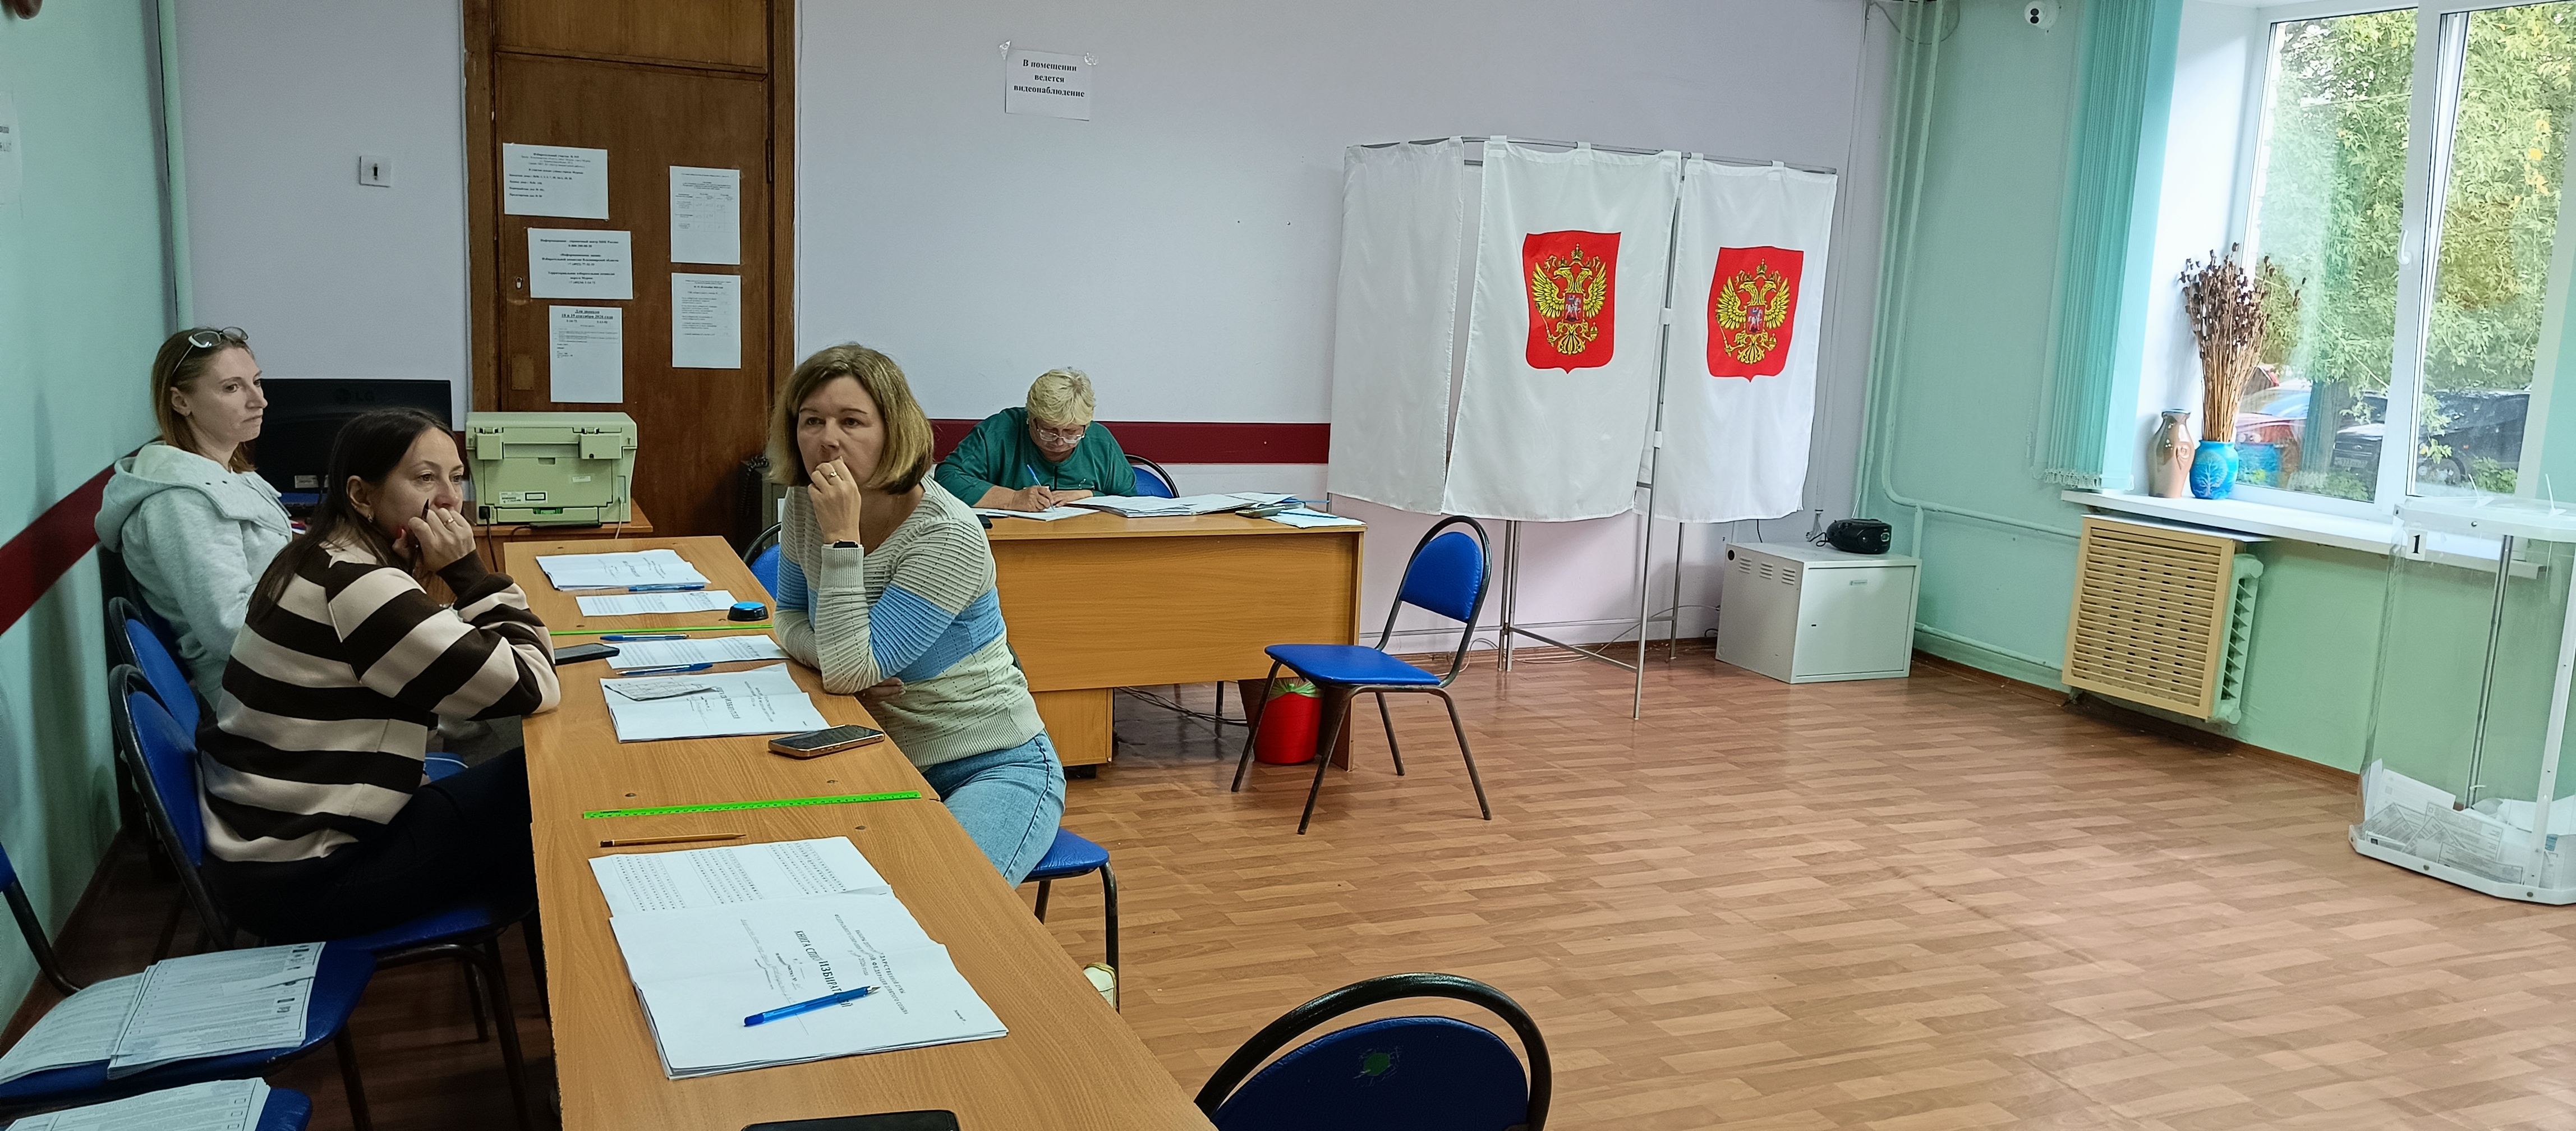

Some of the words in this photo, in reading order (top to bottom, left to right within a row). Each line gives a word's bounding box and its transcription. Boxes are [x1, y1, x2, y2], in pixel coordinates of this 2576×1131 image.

[1031, 62, 1077, 71] помещении
[1013, 85, 1085, 97] видеонаблюдение
[2412, 534, 2421, 554] 1
[794, 931, 811, 948] КНИГА
